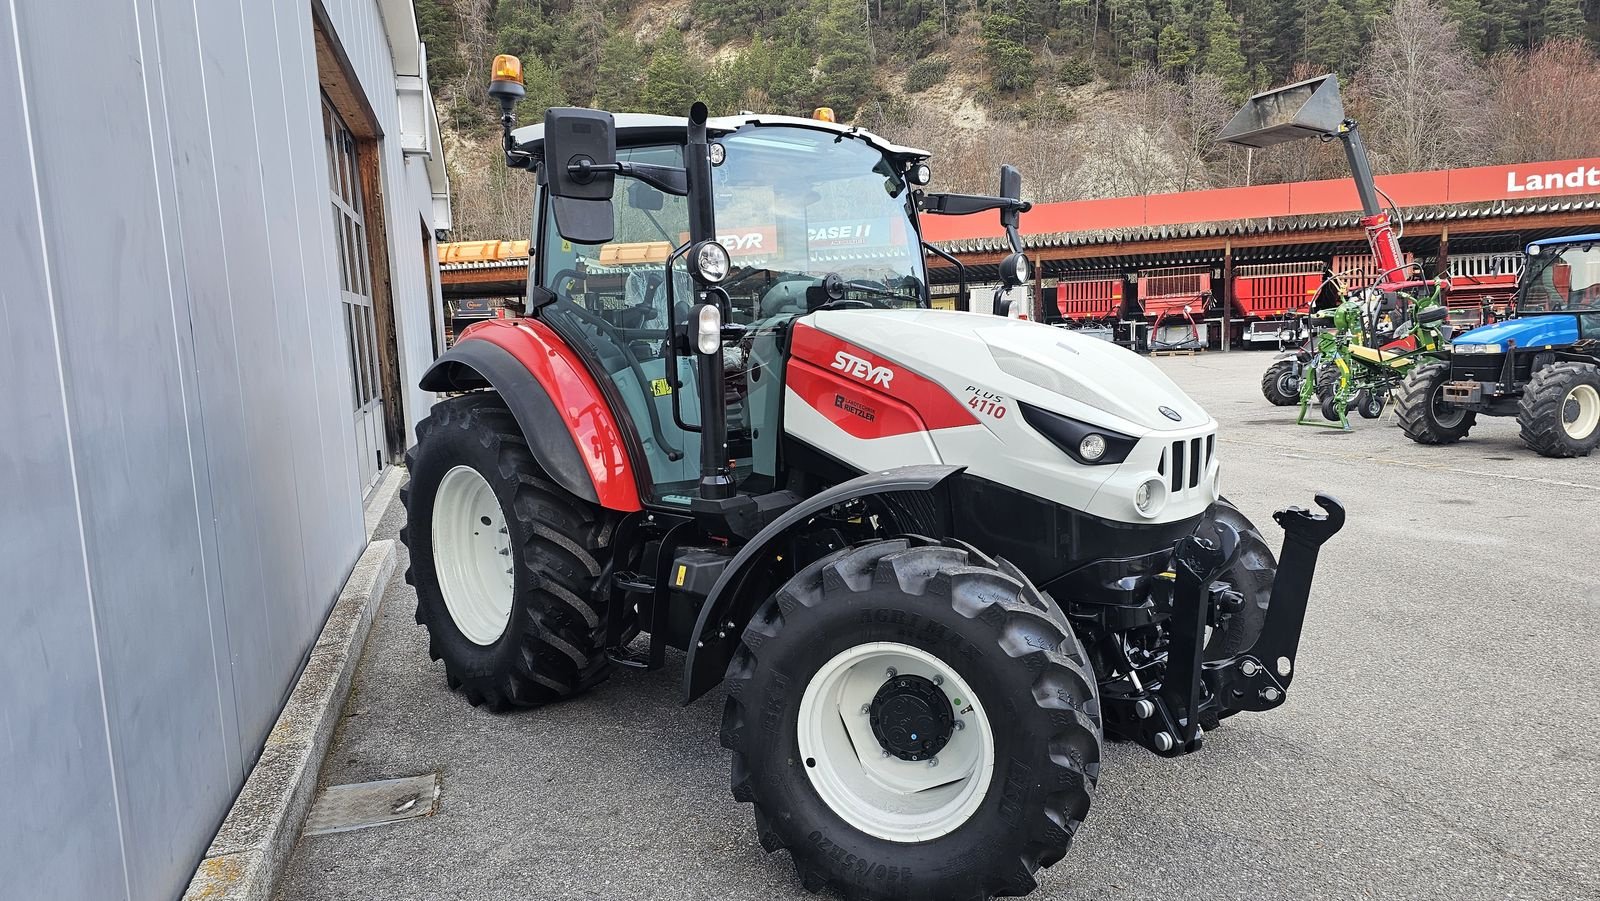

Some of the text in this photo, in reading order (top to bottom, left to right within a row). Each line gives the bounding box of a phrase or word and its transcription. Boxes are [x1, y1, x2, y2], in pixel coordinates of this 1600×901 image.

[1507, 166, 1600, 192] Landt
[808, 225, 852, 241] CASE
[830, 350, 894, 389] STEYR
[965, 385, 1004, 403] PLUS
[844, 403, 875, 423] RIETZLER
[968, 396, 1007, 420] 4110
